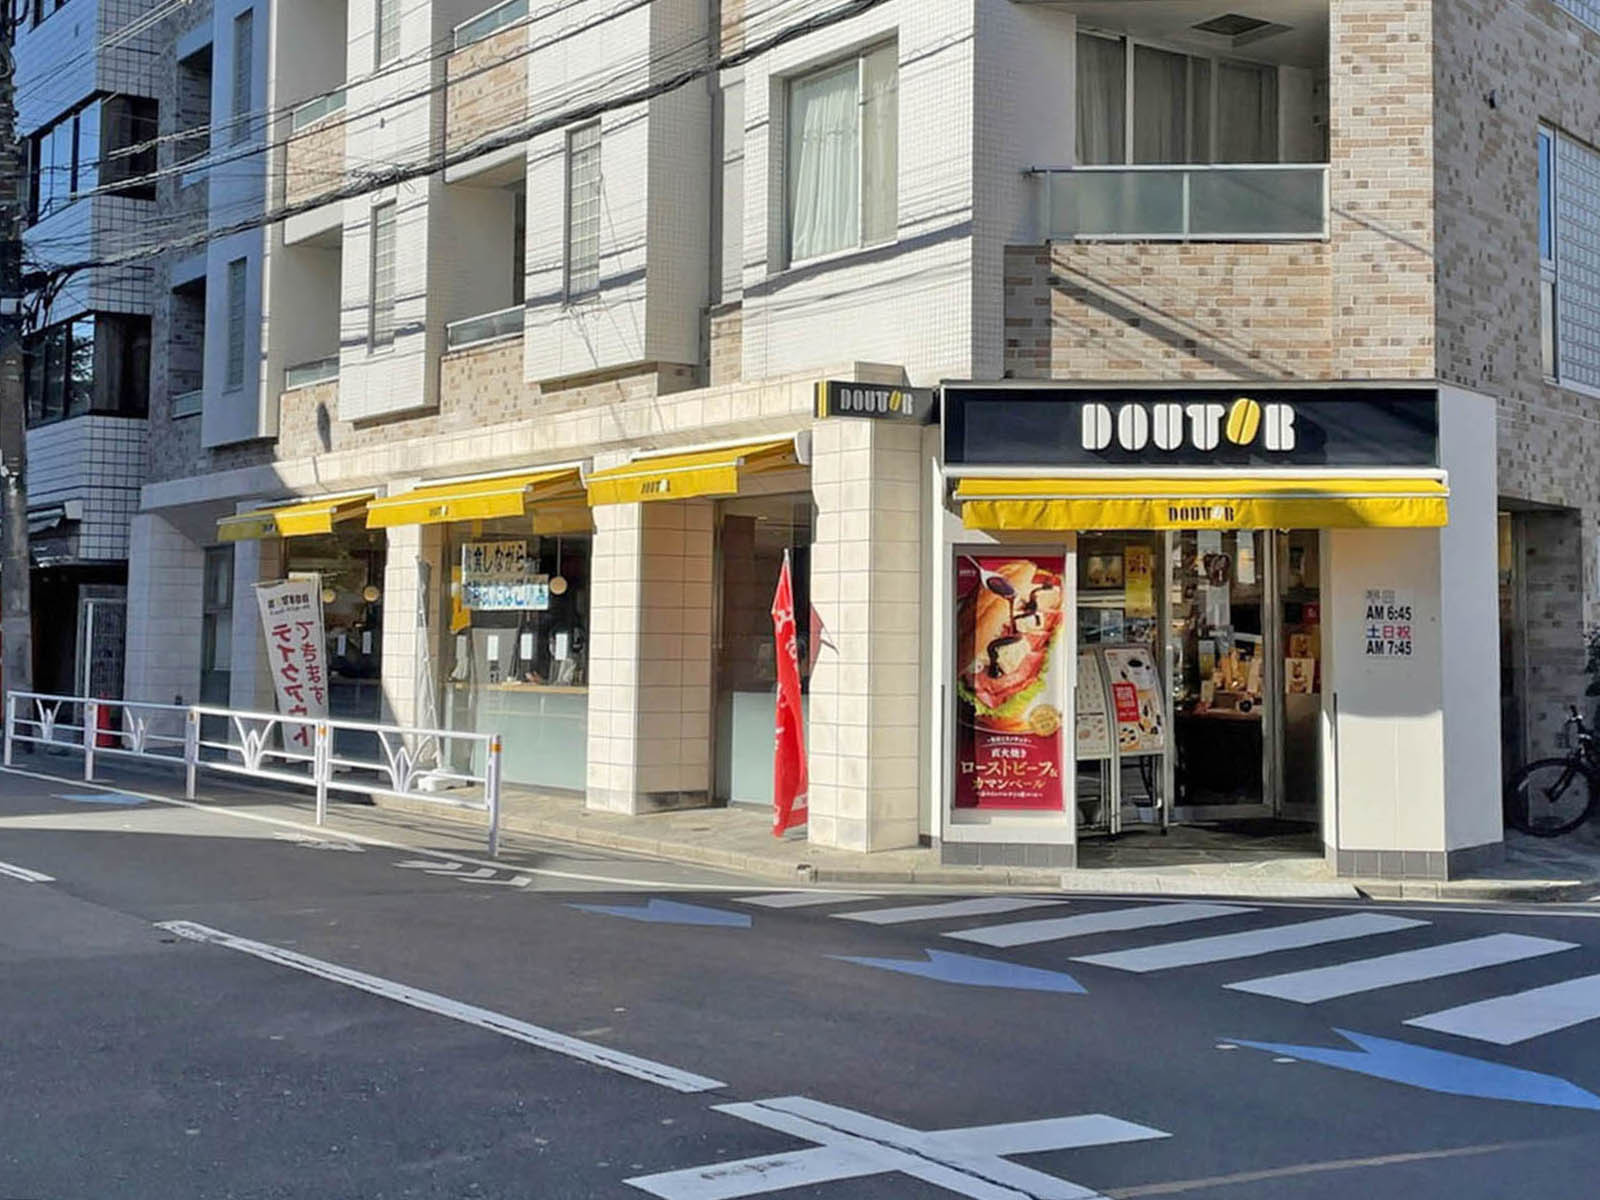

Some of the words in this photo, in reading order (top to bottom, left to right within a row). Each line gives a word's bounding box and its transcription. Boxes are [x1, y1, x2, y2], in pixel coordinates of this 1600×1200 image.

[840, 388, 912, 415] DOUTOR
[1082, 398, 1295, 450] DOUTOR
[1168, 506, 1235, 522] DOUTOR
[1366, 605, 1384, 620] AM
[1387, 605, 1412, 620] 6:45
[1366, 624, 1411, 639] 土日祝
[1366, 640, 1384, 655] AM
[1387, 640, 1412, 655] 7:45
[971, 776, 1047, 791] カマンベール
